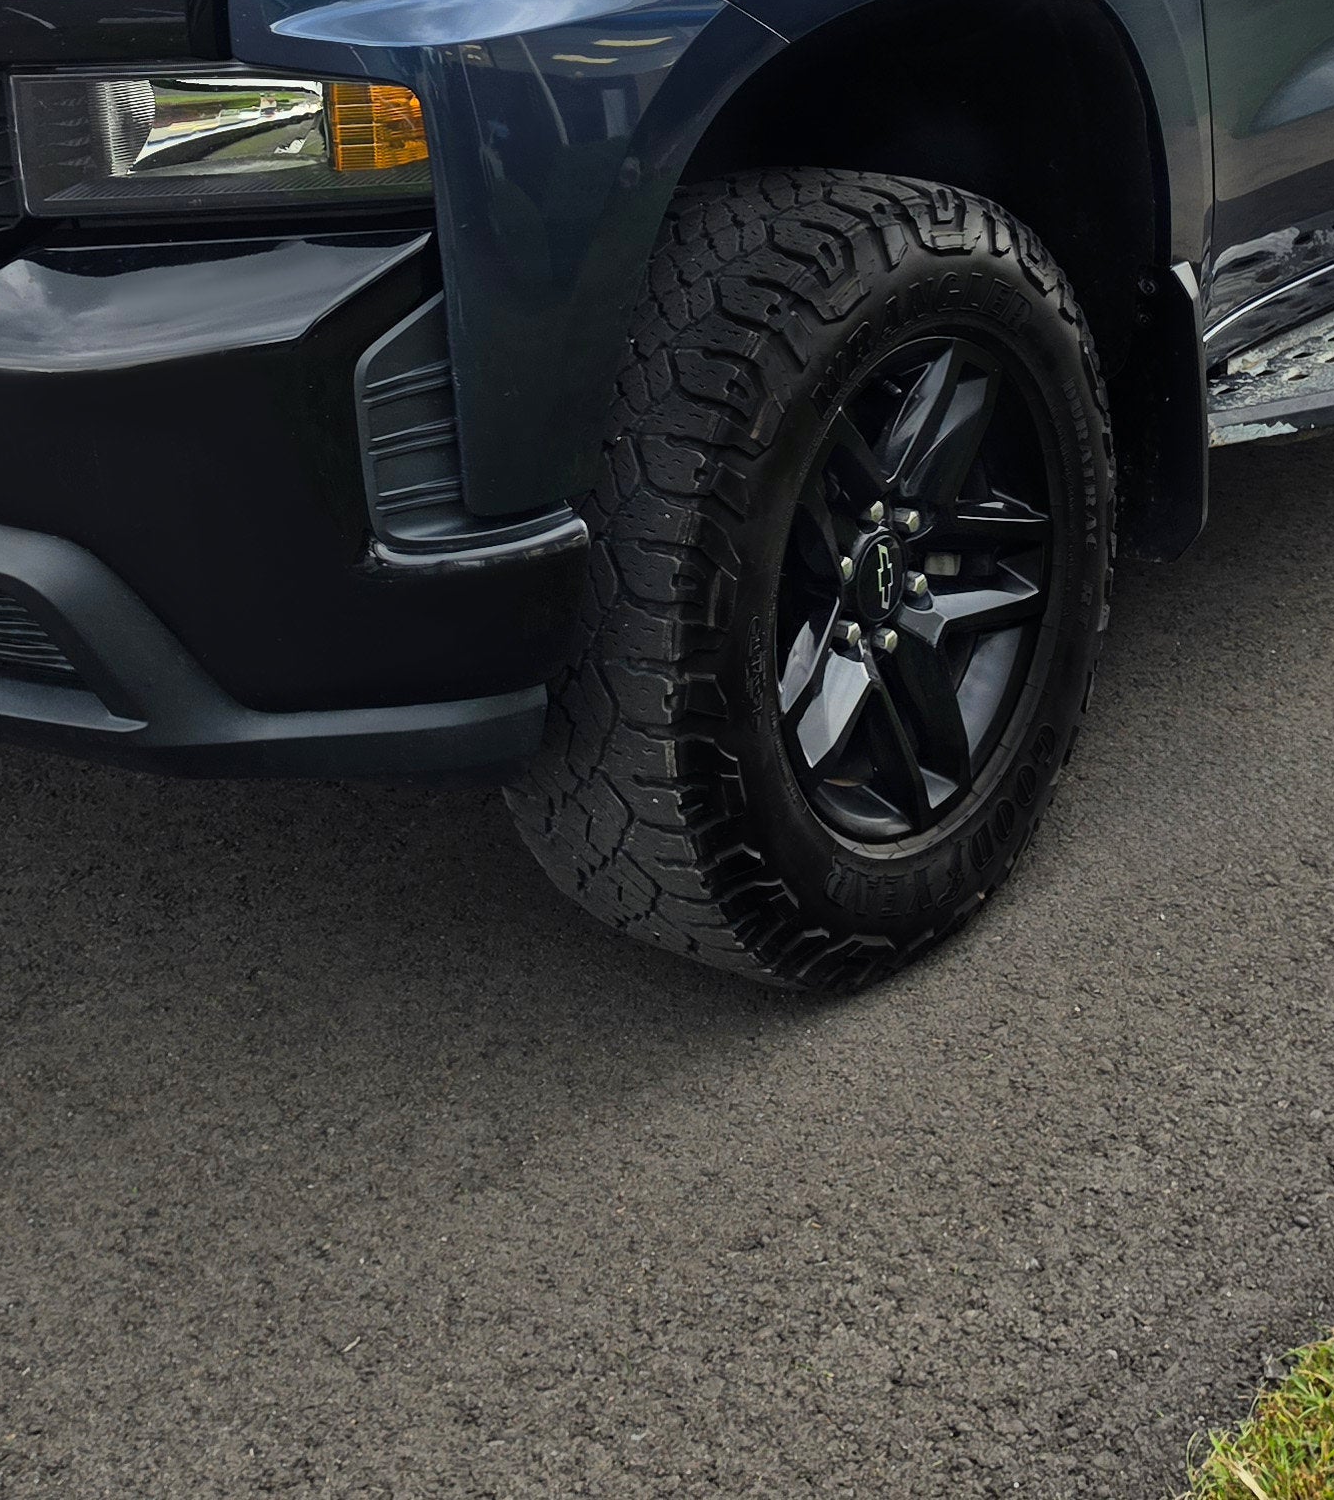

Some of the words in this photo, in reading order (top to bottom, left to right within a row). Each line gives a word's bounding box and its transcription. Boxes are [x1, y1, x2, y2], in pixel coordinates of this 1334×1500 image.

[809, 271, 1033, 420] WRANGLER
[1060, 376, 1098, 553] DURATRAC
[823, 722, 1056, 918] GOODYEAR
